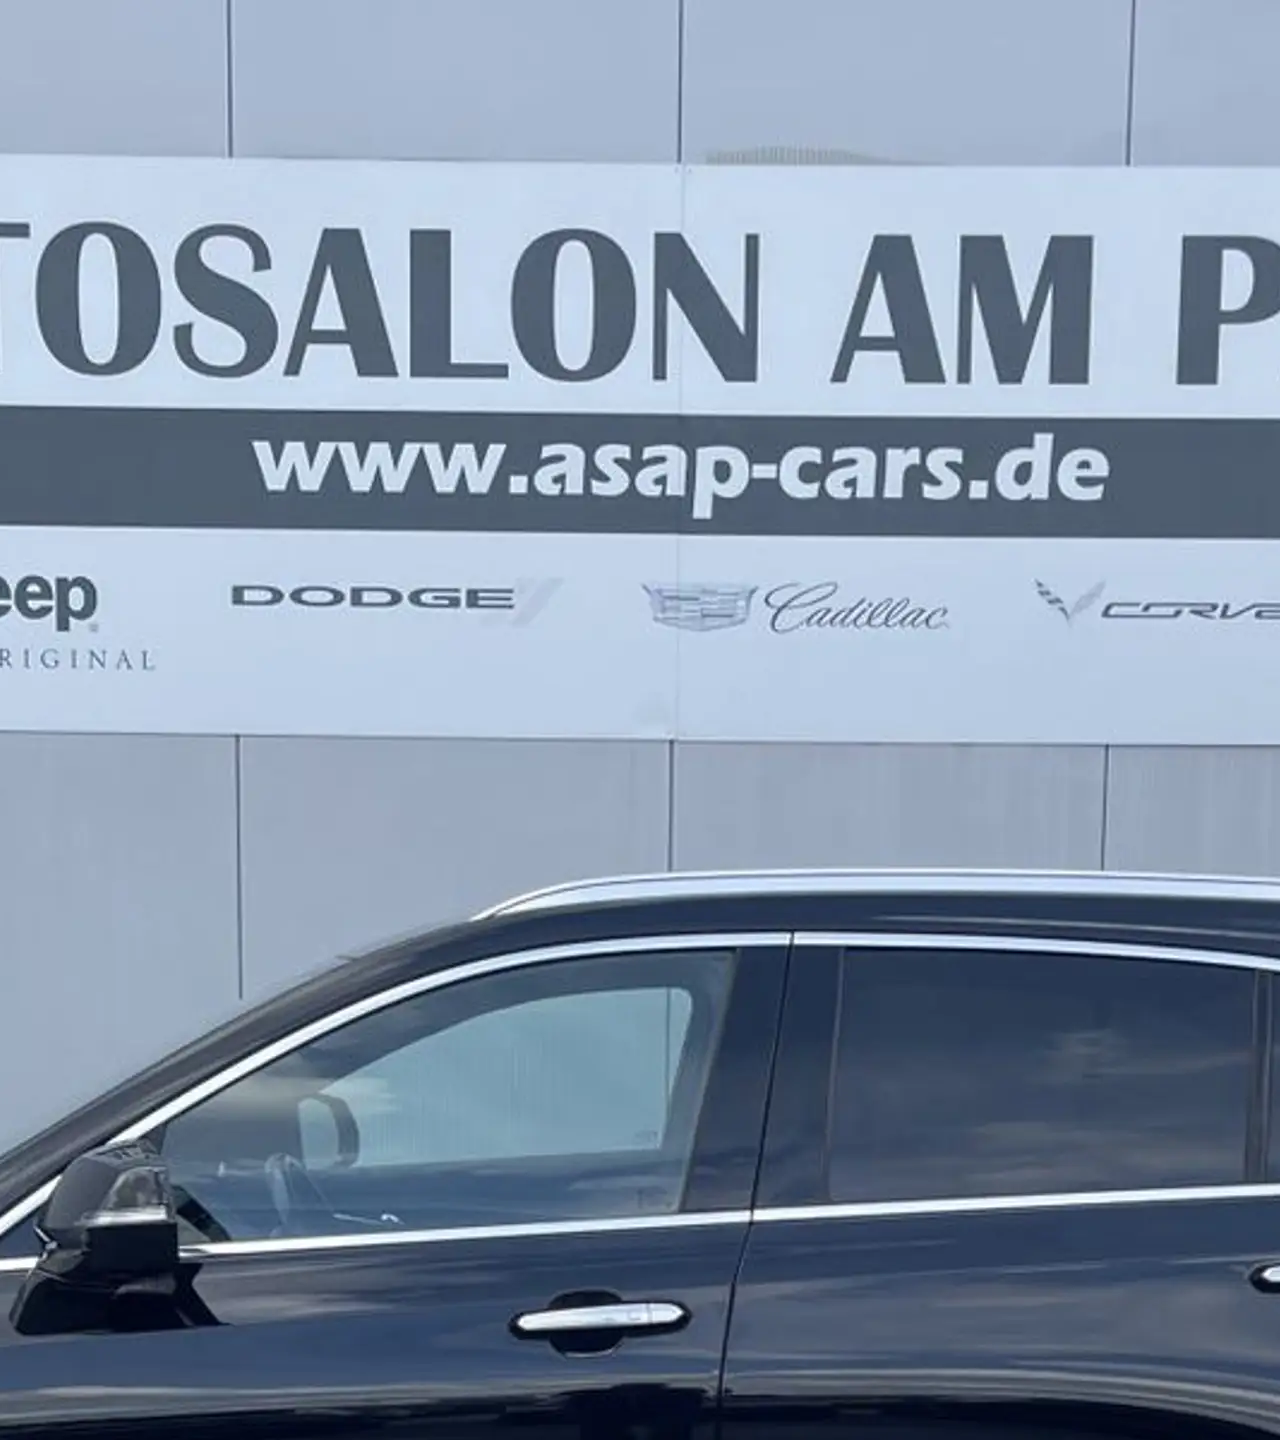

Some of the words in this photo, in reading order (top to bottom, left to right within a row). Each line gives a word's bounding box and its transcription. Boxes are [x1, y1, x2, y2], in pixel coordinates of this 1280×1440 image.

[831, 235, 1093, 384] AM
[252, 433, 1109, 519] www.asap-cars.de
[232, 586, 515, 609] DODGE
[764, 581, 949, 634] Cadillac
